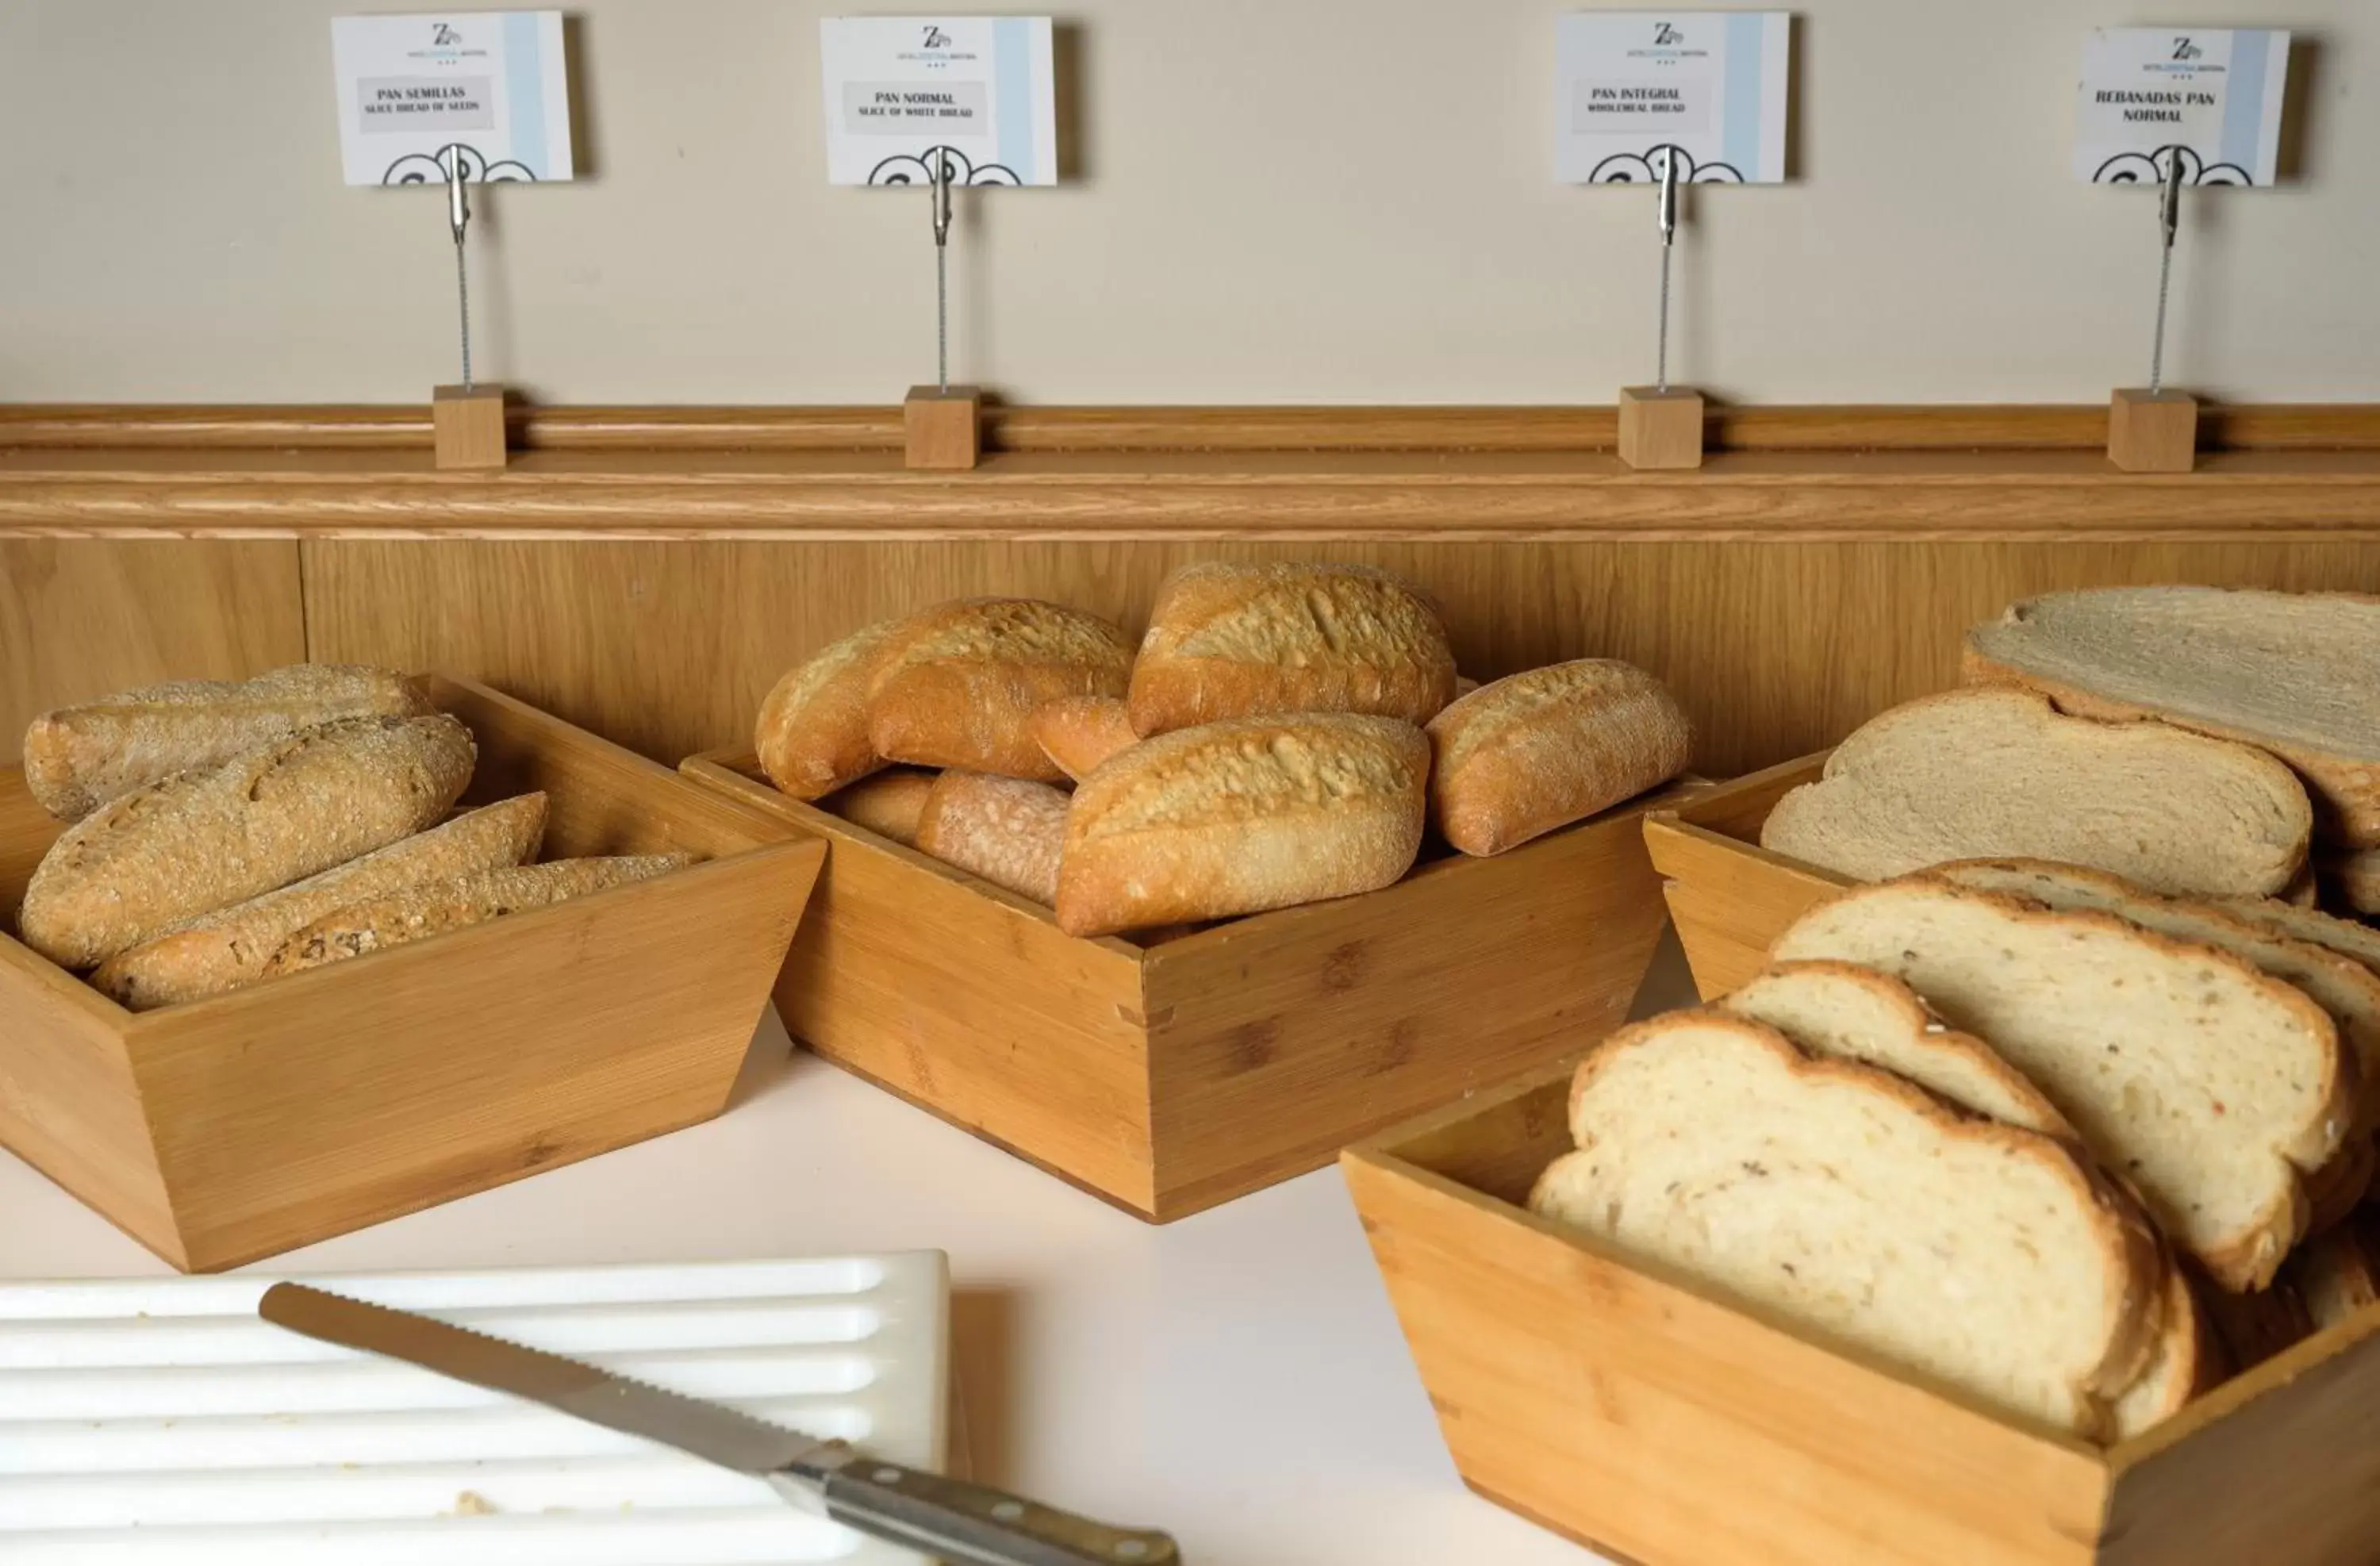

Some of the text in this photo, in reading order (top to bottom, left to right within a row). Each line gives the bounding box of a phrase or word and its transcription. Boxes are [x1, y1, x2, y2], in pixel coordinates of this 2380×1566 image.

[377, 86, 466, 101] PAN SEMILLAS
[875, 92, 955, 104] PAN NORMAL
[1591, 88, 1681, 100] PAN INTEGRAL
[2096, 90, 2216, 106] REBANADAS PAN
[364, 102, 480, 114] SLICE BREAD OF SEEDS
[858, 107, 973, 118] SLICE OF WHITE BREAD
[1587, 103, 1686, 113] WHOLEMEAL BREAD
[2122, 109, 2182, 122] NORMAL
